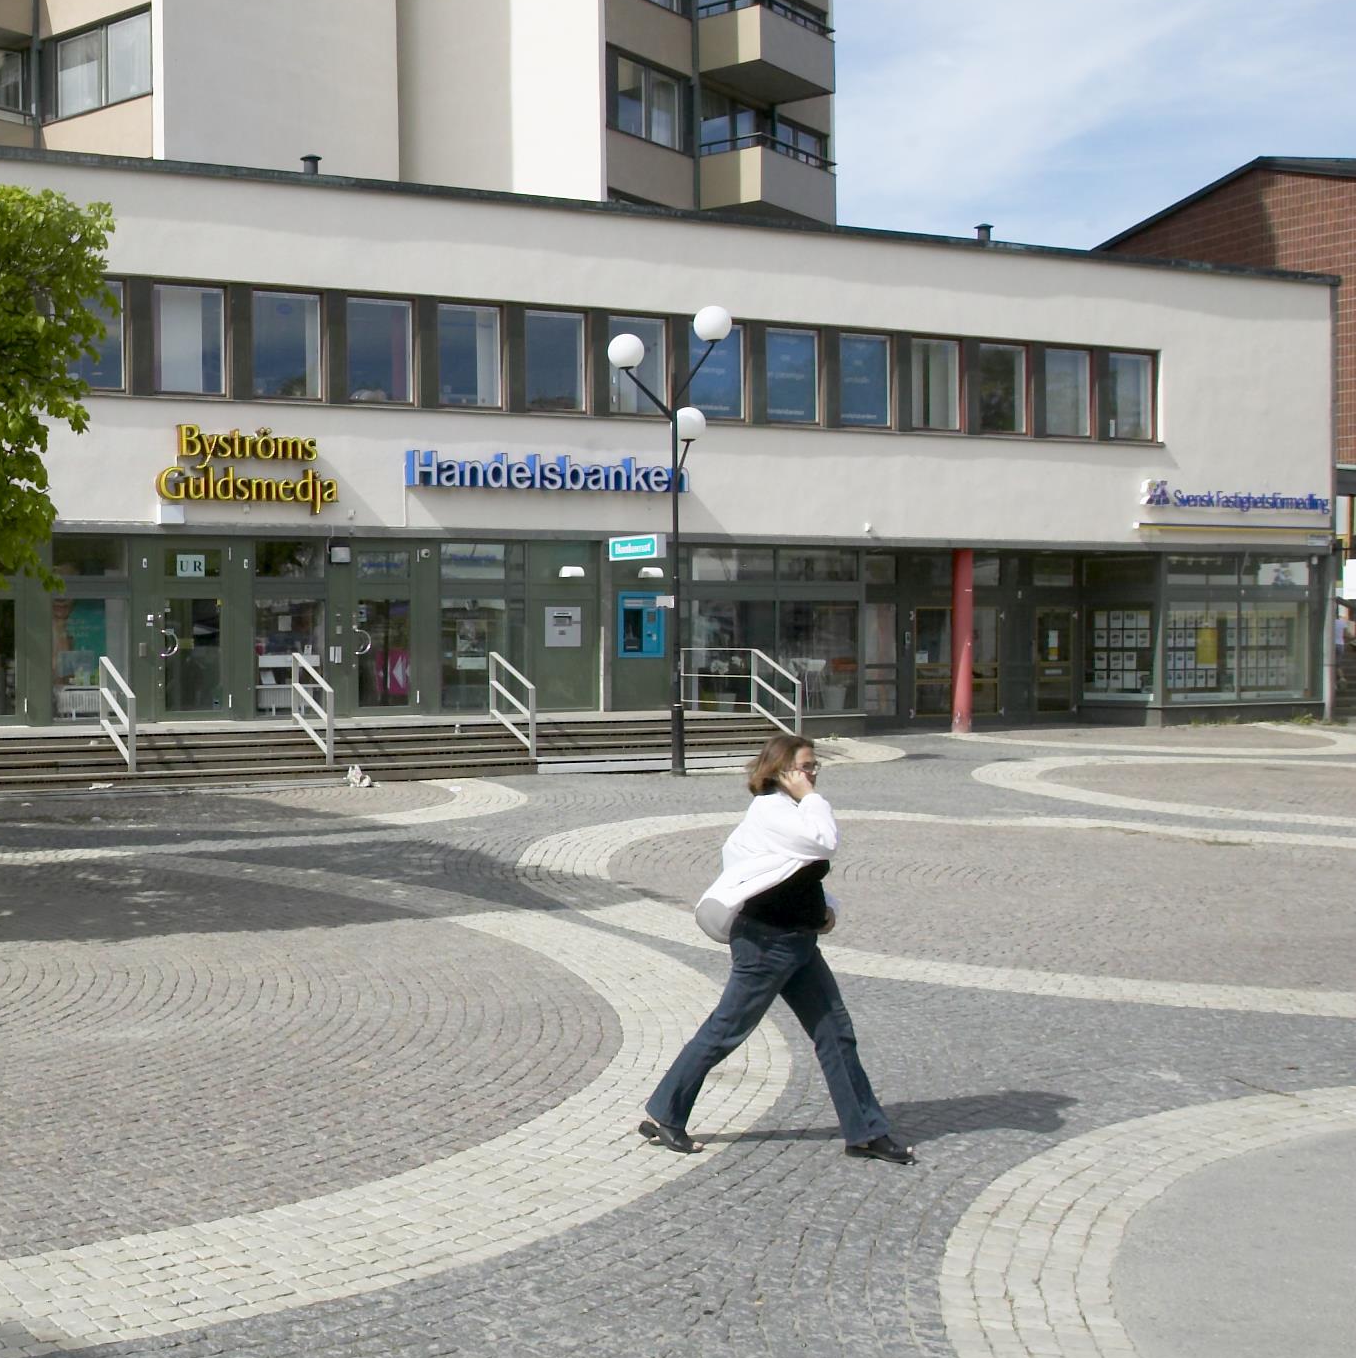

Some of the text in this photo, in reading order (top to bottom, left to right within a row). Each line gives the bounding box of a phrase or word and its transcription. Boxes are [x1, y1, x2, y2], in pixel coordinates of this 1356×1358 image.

[177, 424, 317, 469] Byströms
[155, 466, 339, 515] Guldsmedja
[405, 449, 690, 493] Handelsbanken
[1173, 490, 1215, 508] Svensk
